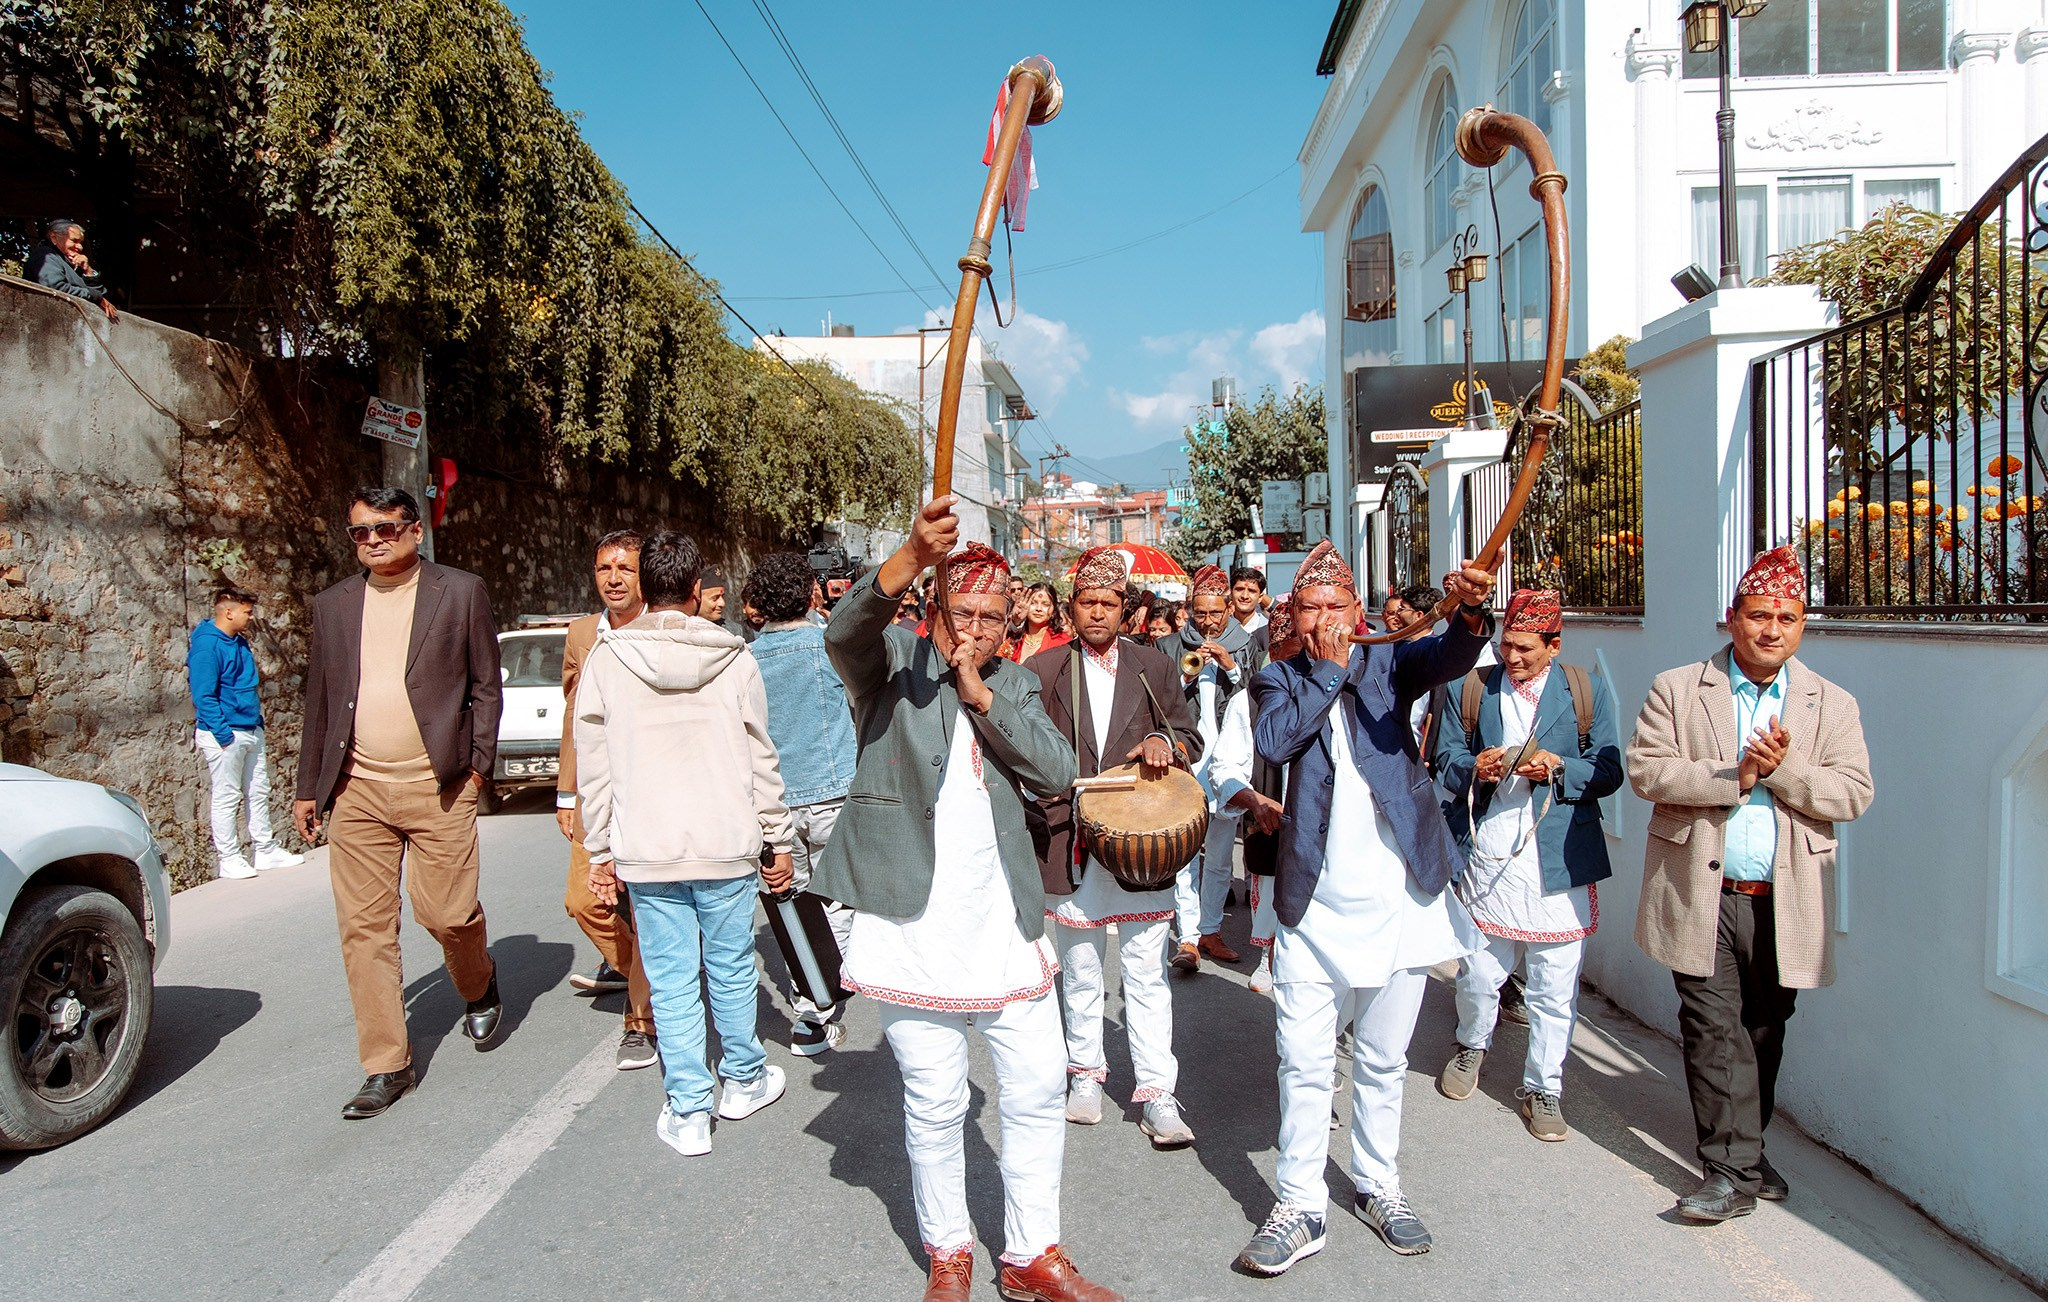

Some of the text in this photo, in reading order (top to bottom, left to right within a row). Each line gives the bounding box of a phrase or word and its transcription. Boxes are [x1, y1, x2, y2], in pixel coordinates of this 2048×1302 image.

[368, 407, 403, 422] GRANDE
[371, 429, 389, 439] BASED
[391, 435, 413, 446] SCHOOL
[1374, 432, 1404, 441] WEDDING
[1409, 430, 1446, 440] RECEPTION
